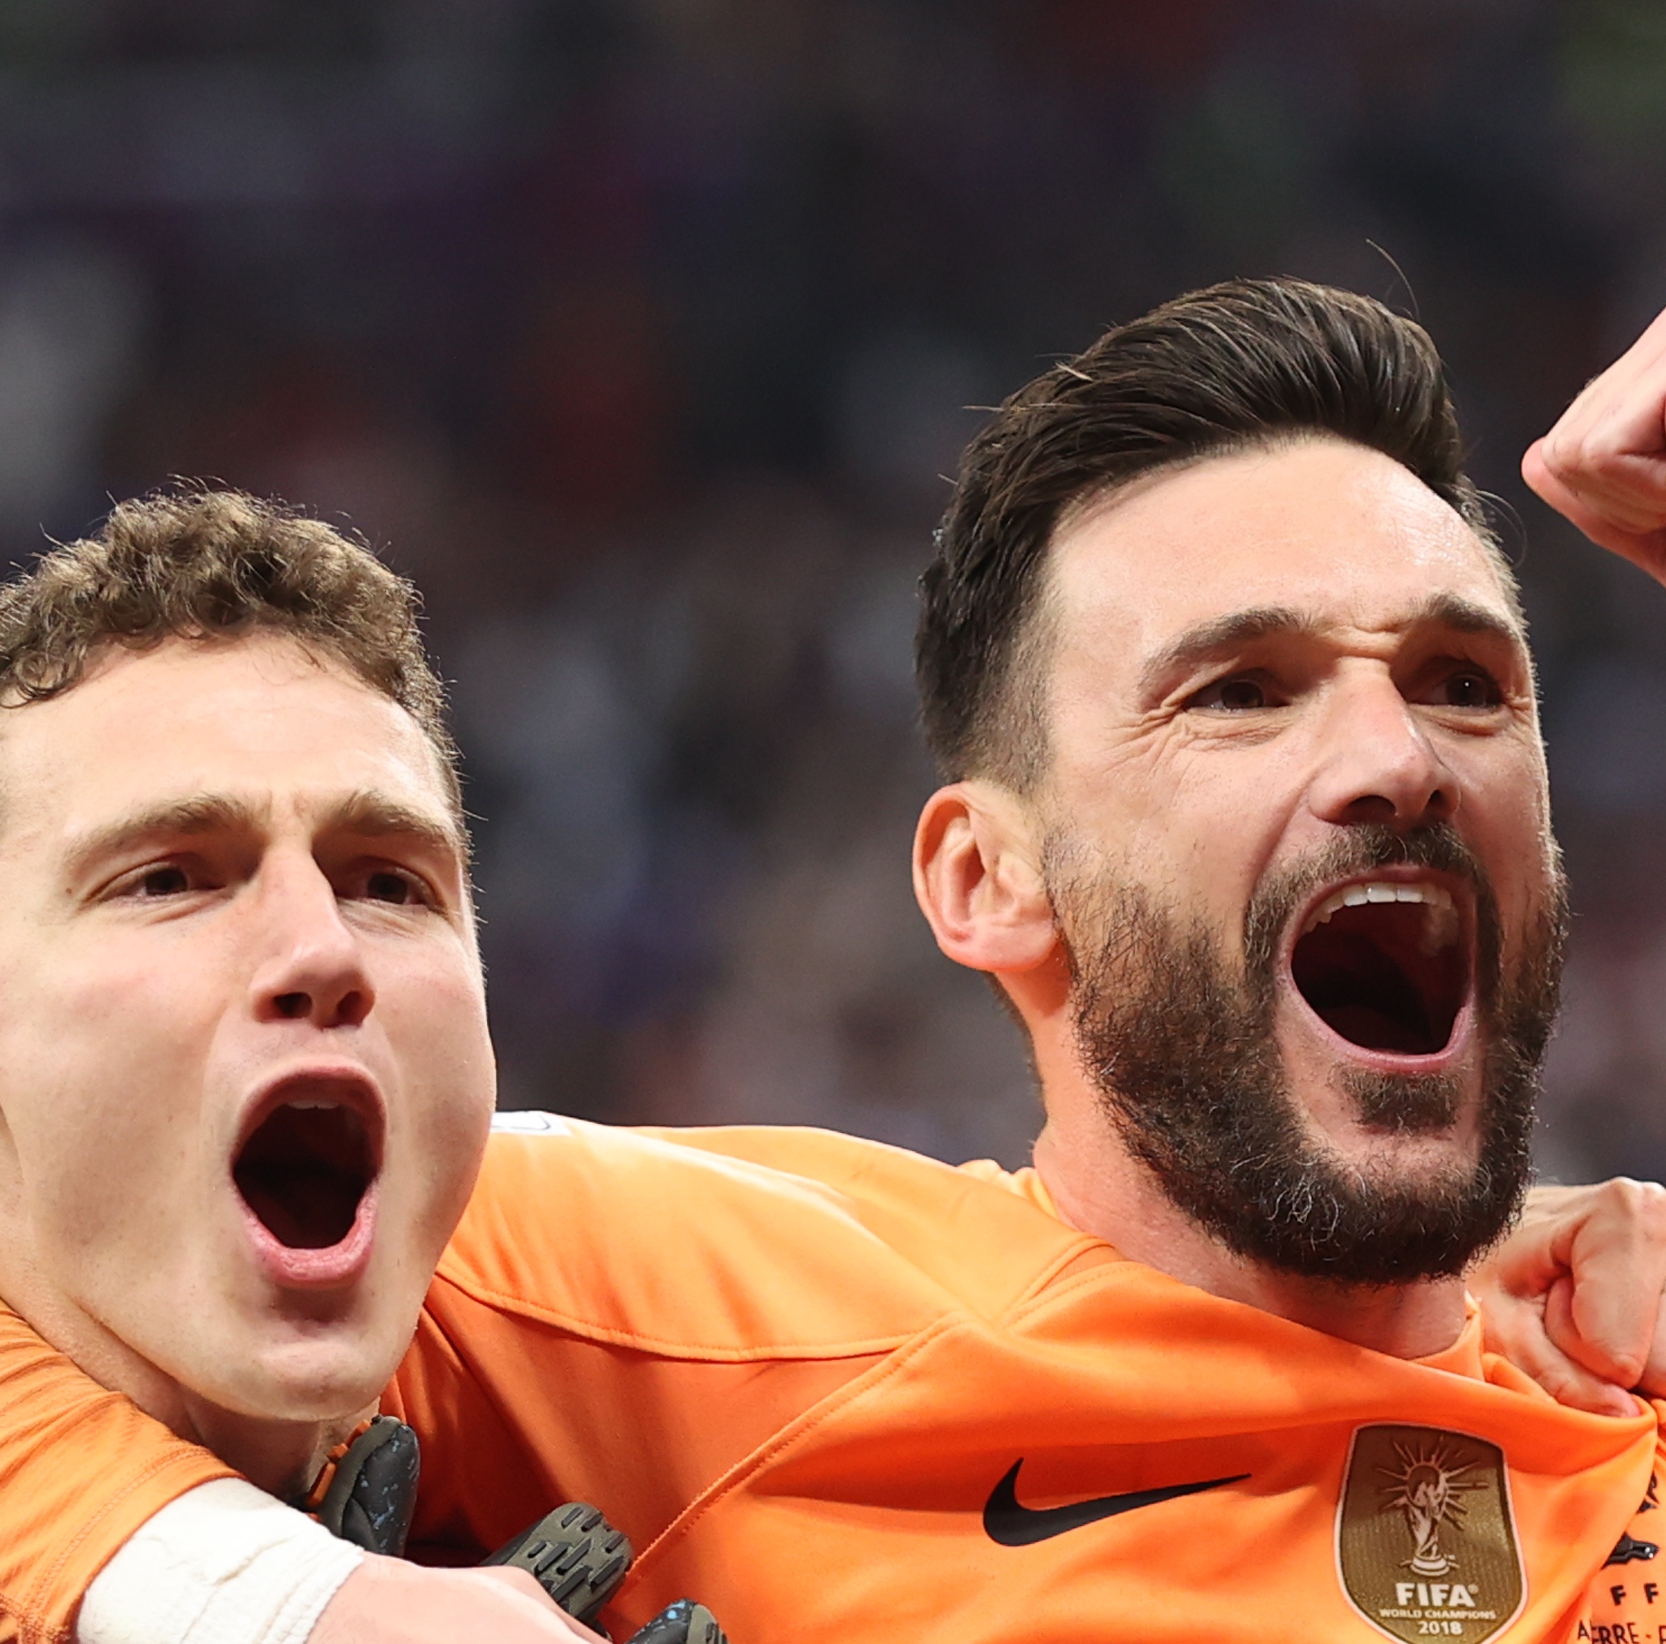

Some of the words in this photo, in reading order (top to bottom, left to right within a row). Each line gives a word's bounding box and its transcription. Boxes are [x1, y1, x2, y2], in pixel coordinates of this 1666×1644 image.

[1395, 1582, 1476, 1608] FIFA
[1379, 1608, 1423, 1619] WORLD
[1424, 1608, 1497, 1621] CHAMPIONS
[1418, 1620, 1463, 1636] 2018
